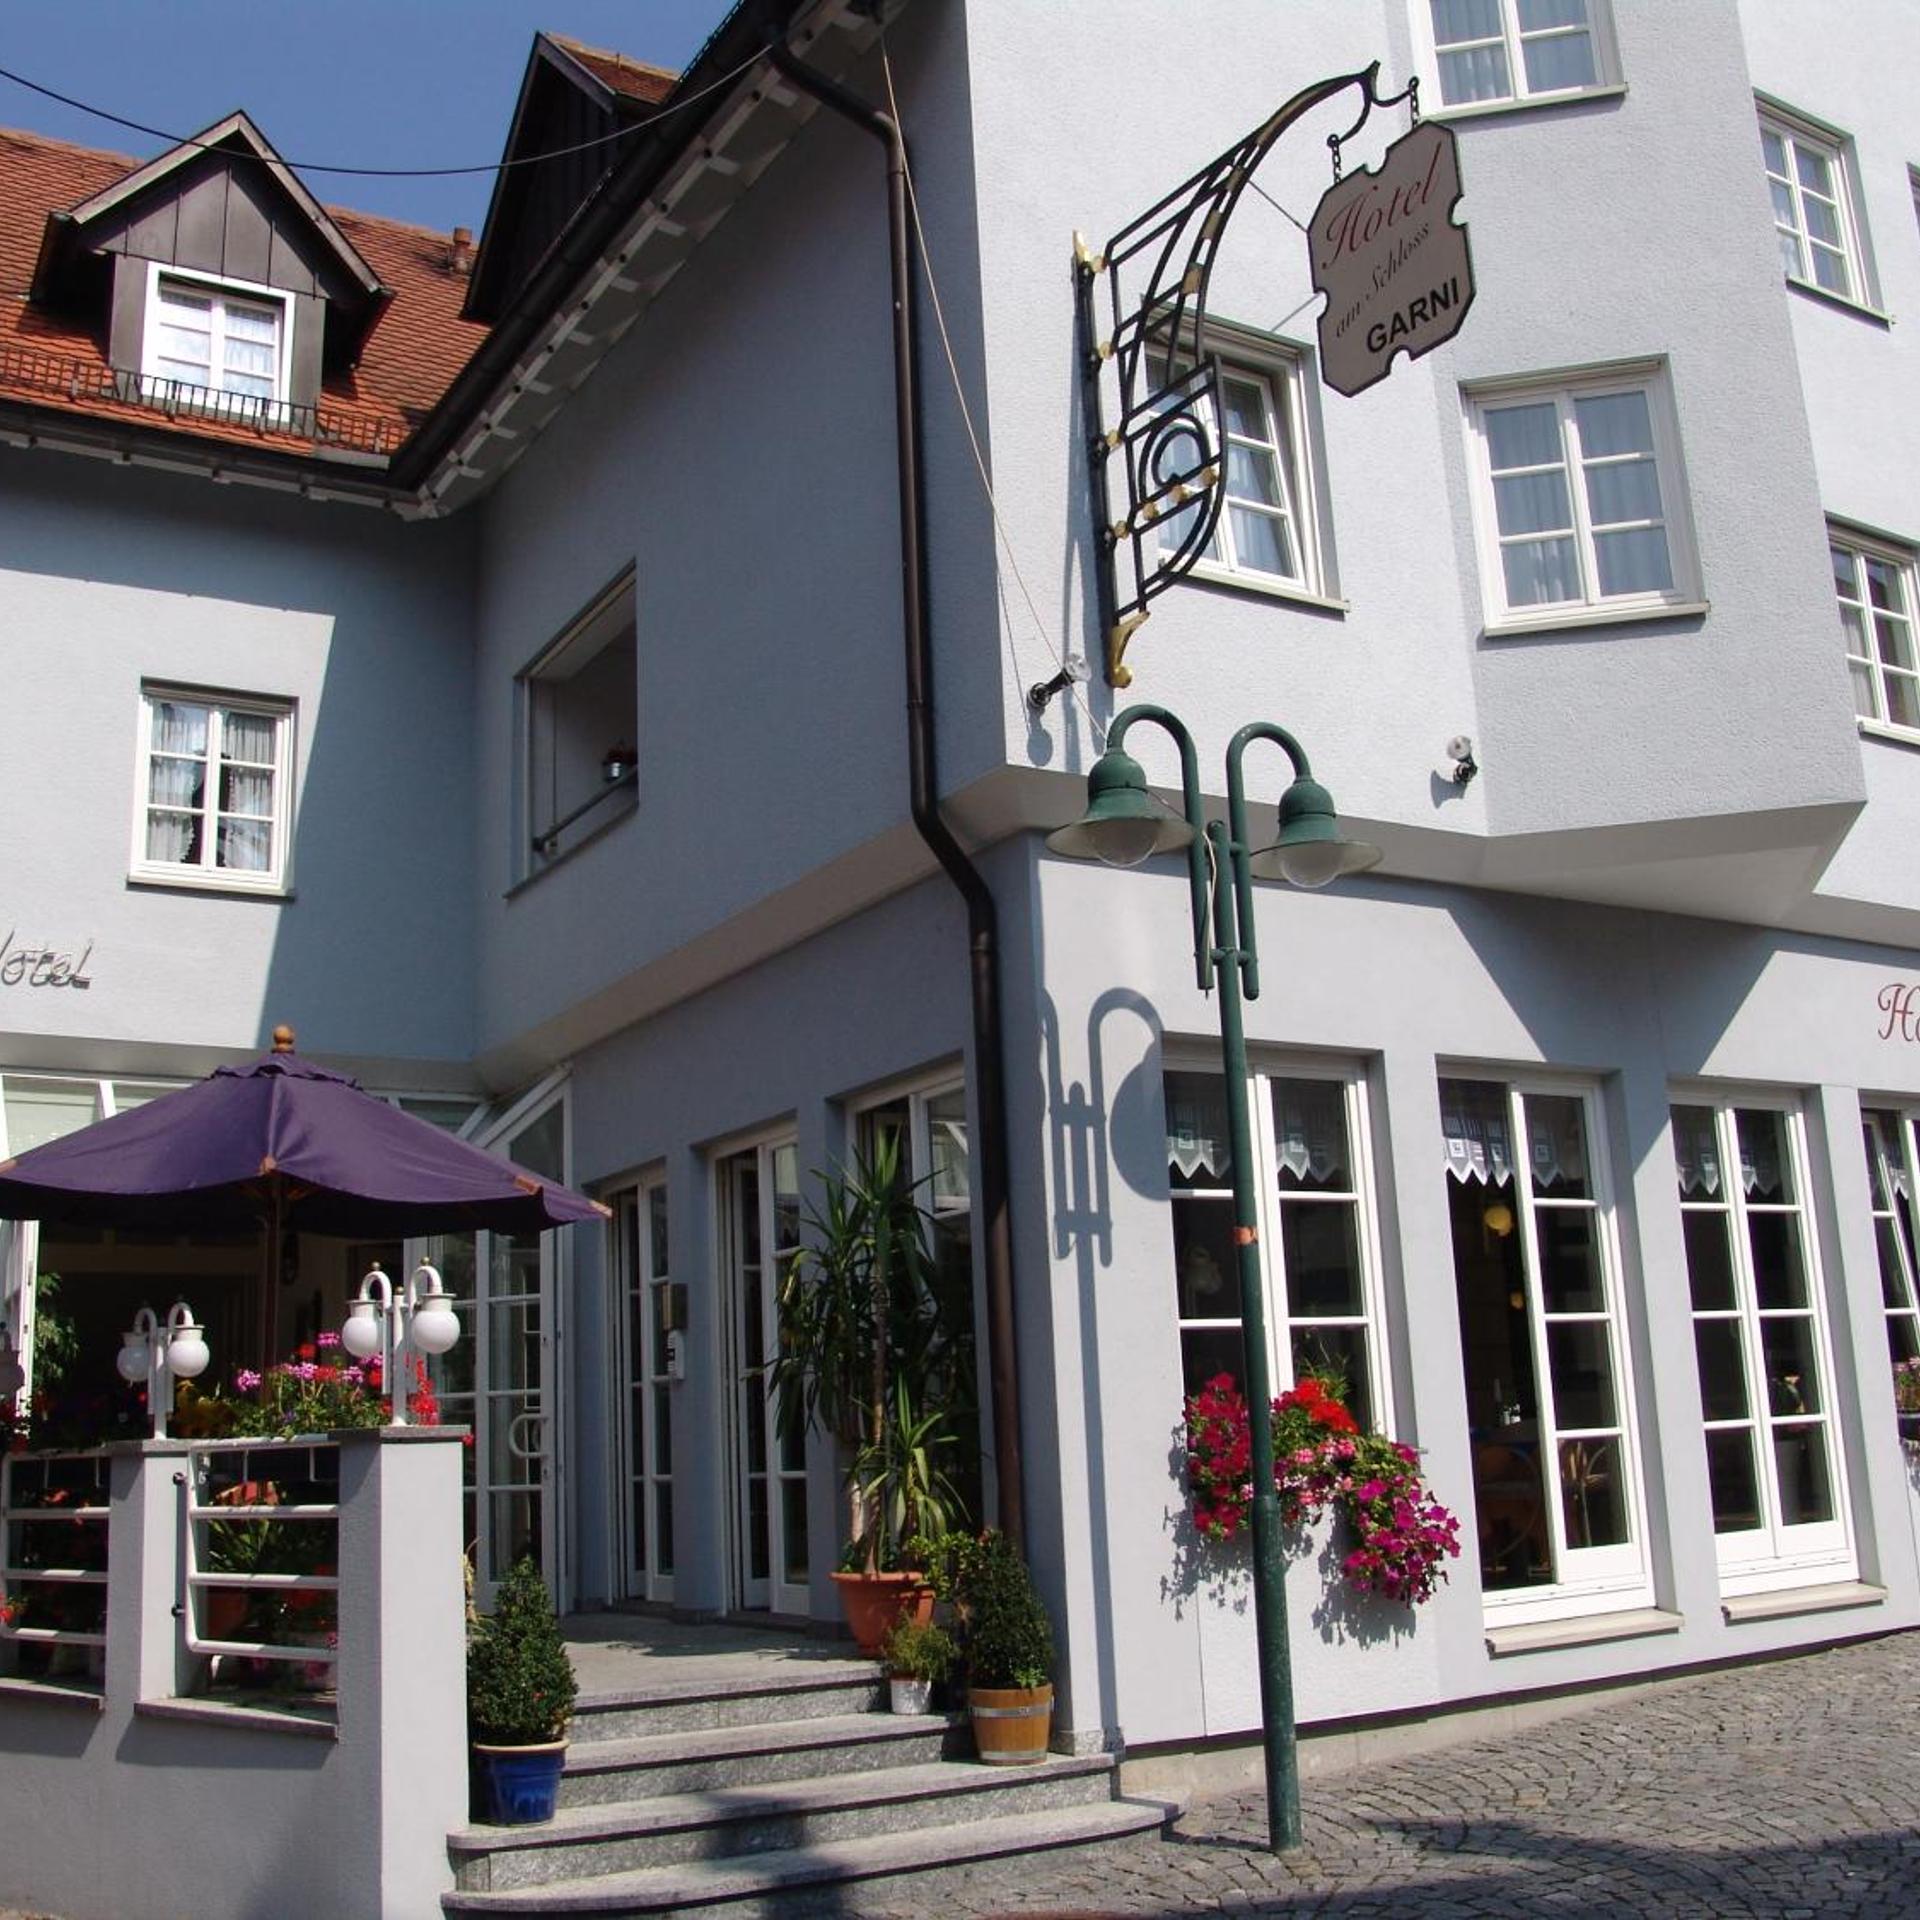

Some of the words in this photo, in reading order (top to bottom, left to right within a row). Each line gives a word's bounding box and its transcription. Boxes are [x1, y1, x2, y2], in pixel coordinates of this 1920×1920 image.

[1321, 141, 1442, 270] Hotel
[1366, 277, 1460, 353] GARNI
[1877, 983, 1920, 1042] H
